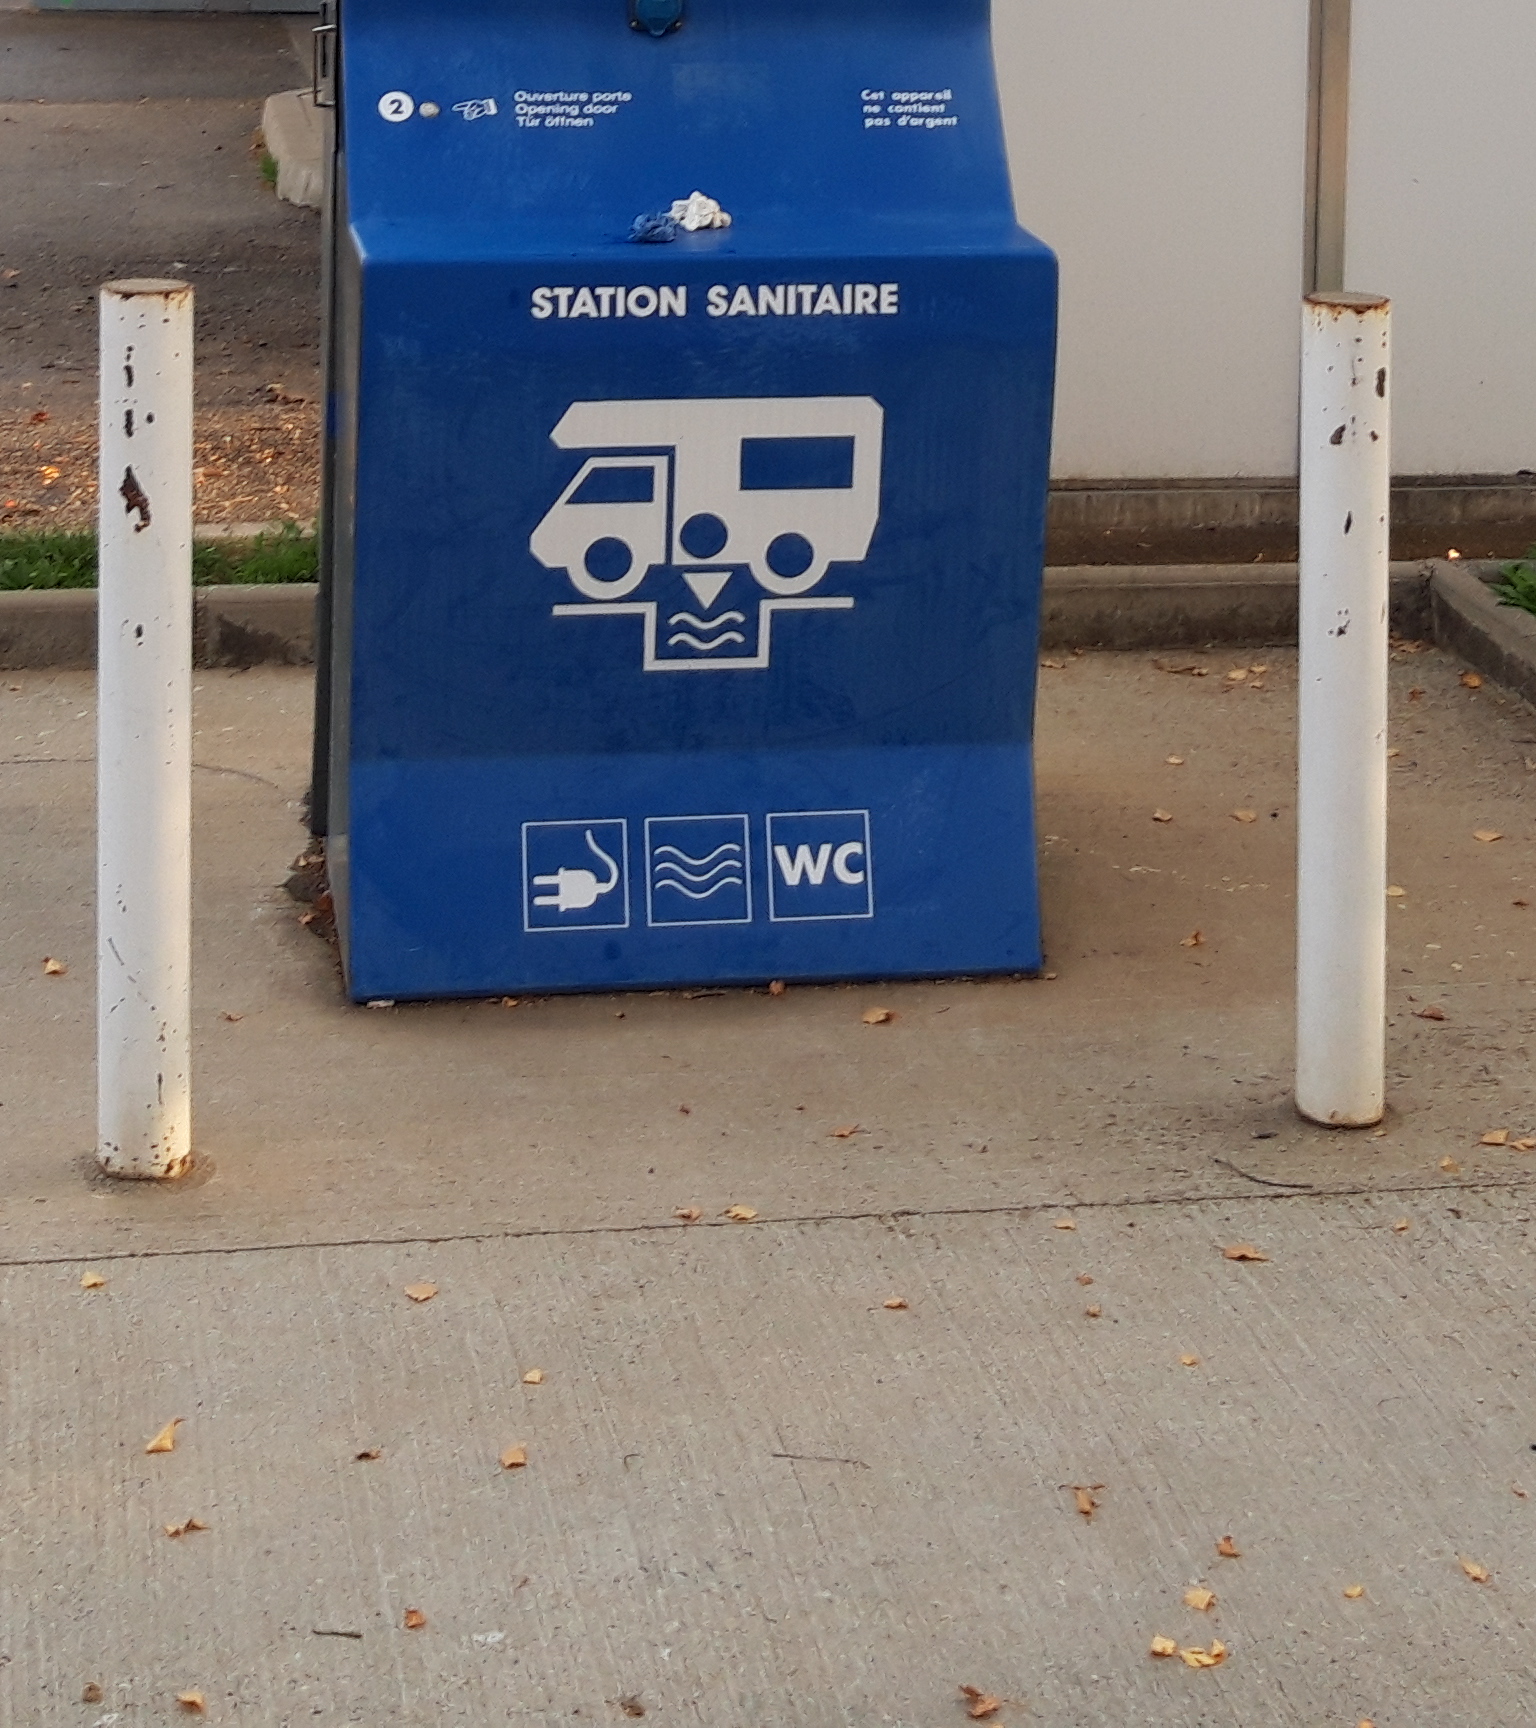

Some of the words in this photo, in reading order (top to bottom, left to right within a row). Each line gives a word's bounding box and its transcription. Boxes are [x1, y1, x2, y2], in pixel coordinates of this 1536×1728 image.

[513, 90, 589, 102] Ouverture
[591, 91, 633, 104] porte
[861, 88, 885, 101] Cet
[891, 88, 953, 103] appareil
[514, 103, 581, 117] Opening
[582, 103, 619, 115] door
[862, 104, 882, 114] ne
[887, 101, 946, 114] contient
[864, 117, 891, 128] pas
[897, 114, 958, 129] d'argent
[530, 285, 687, 319] STATION
[706, 282, 899, 317] SANITAIRE
[774, 841, 865, 887] WC
